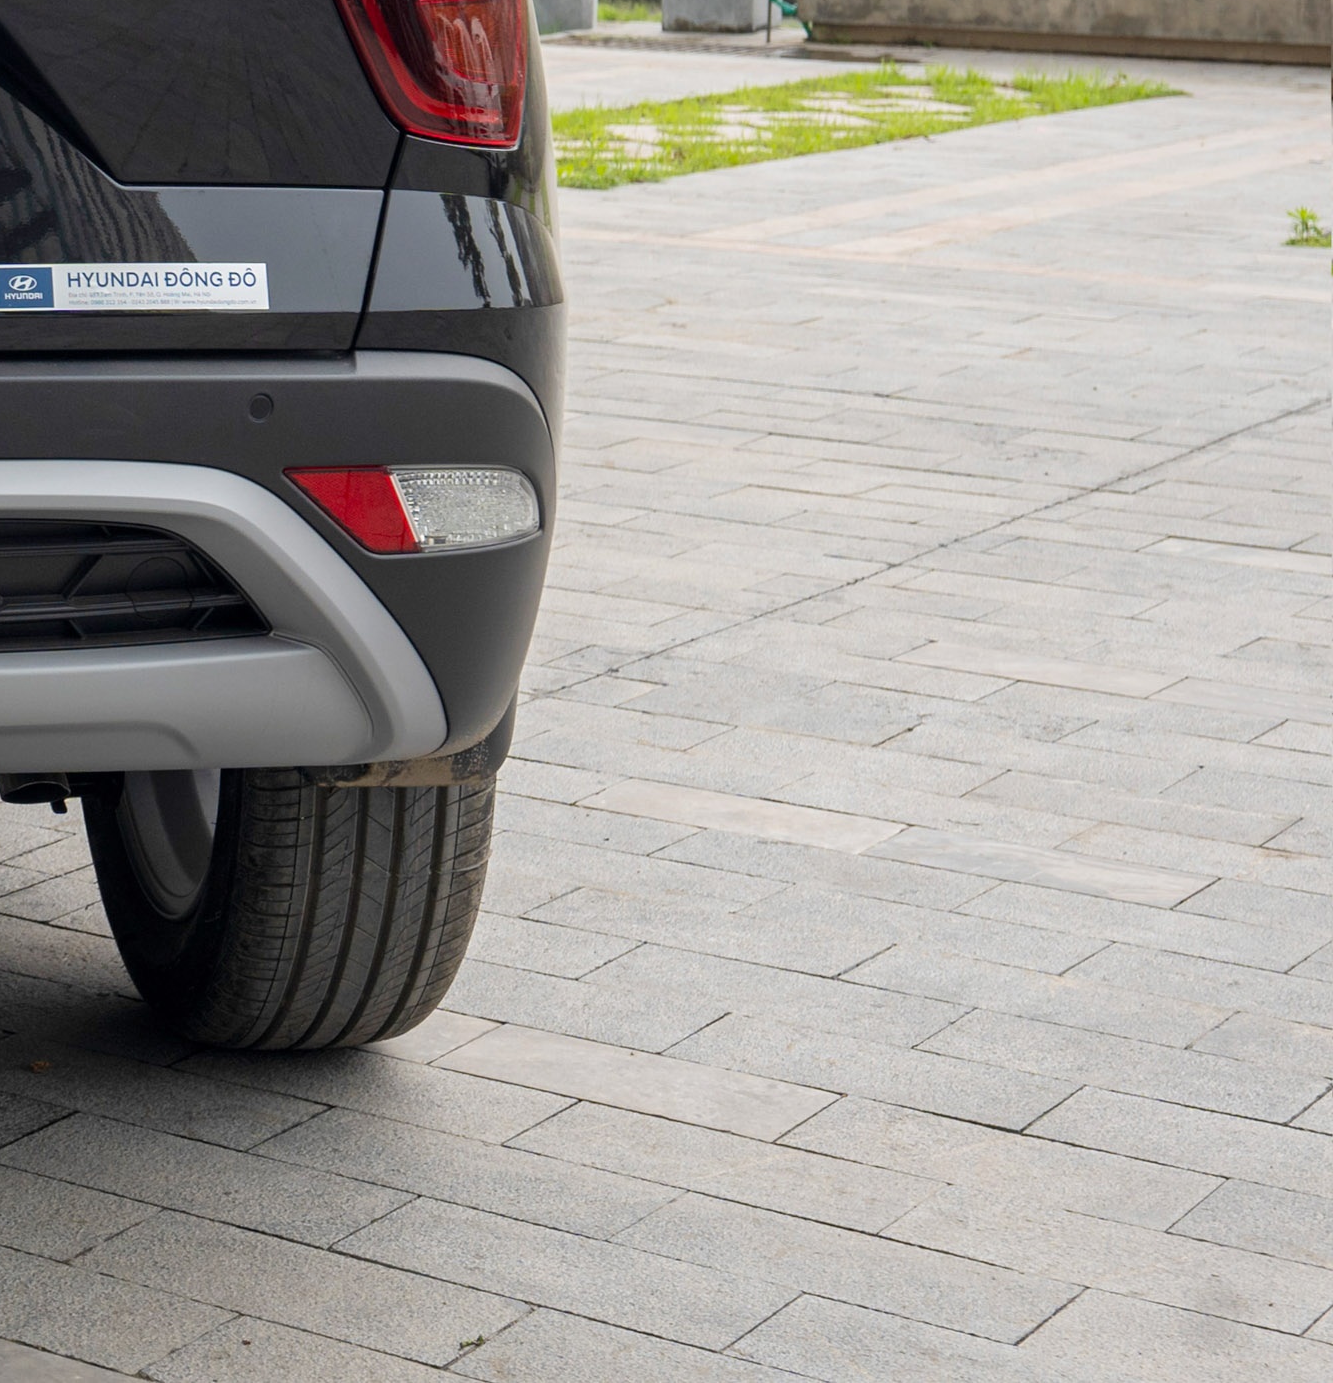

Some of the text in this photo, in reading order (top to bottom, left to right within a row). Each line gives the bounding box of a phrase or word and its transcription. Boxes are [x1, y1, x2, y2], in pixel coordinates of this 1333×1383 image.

[67, 267, 257, 288] HYUNDAI ĐÔNG ĐÔ
[4, 292, 43, 300] HYUNDAI
